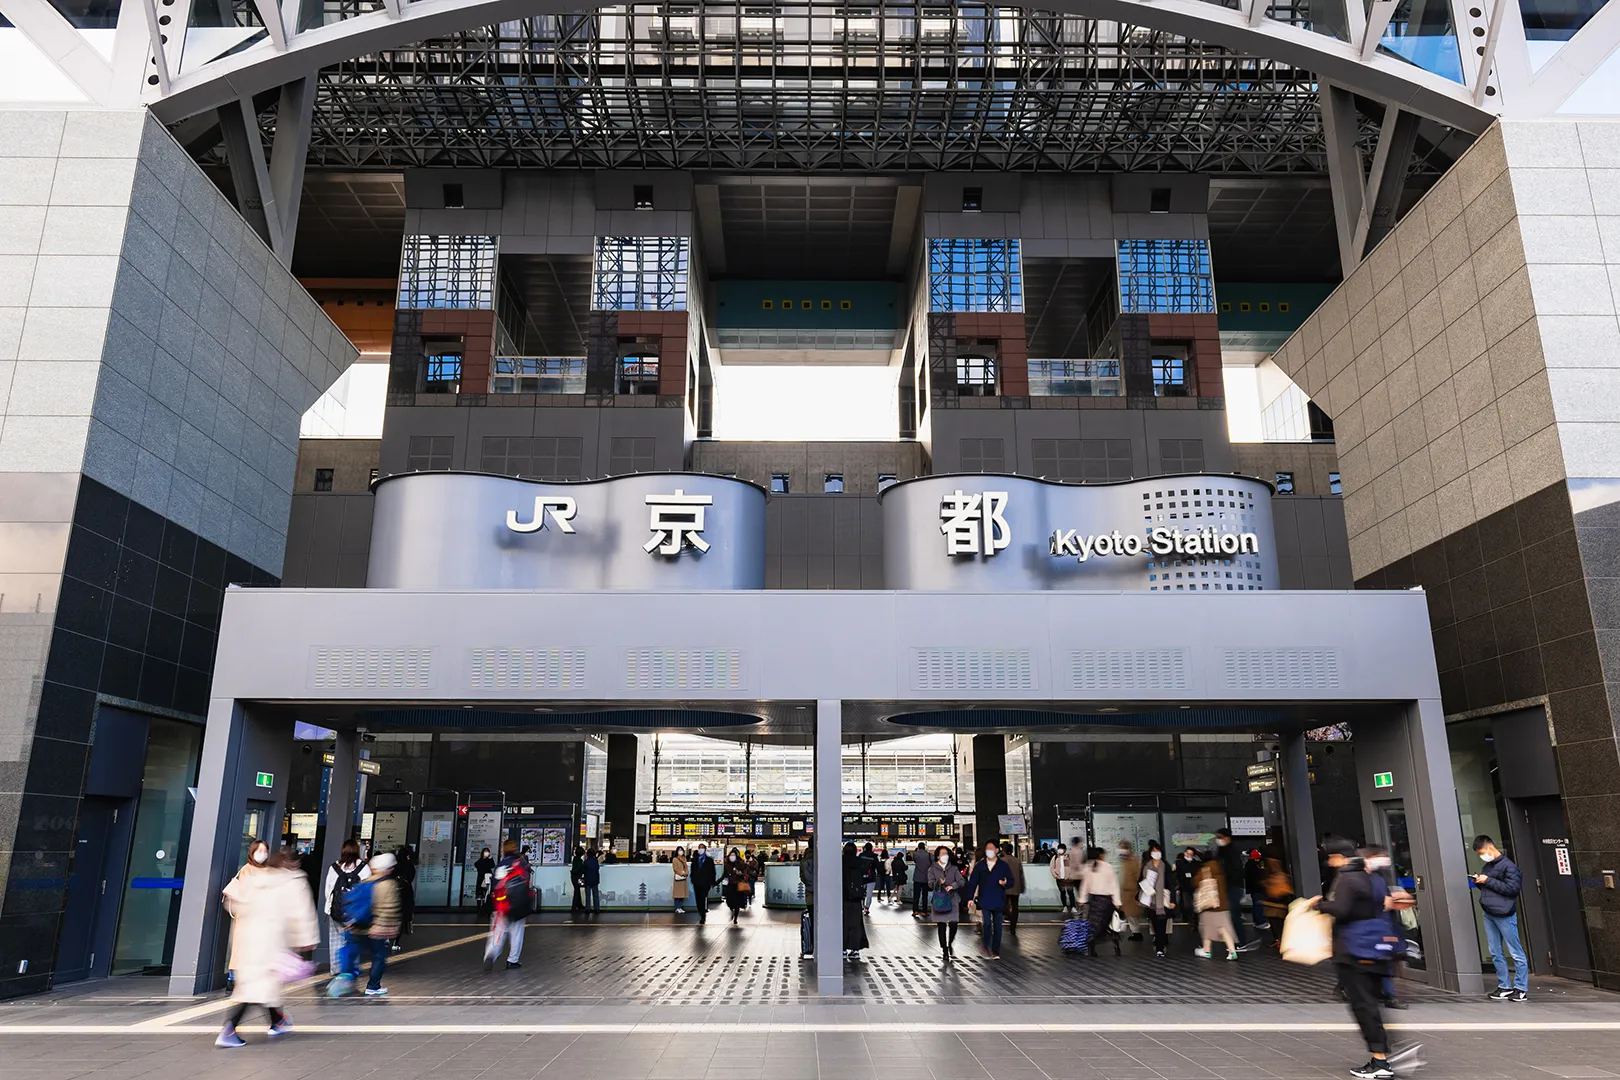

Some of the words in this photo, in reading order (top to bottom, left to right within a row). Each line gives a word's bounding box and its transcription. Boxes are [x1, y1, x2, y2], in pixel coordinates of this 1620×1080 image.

[506, 496, 577, 533] JR
[643, 489, 713, 555] 京
[940, 490, 1011, 556] 都
[1054, 528, 1142, 562] Kyoto
[1151, 527, 1259, 555] Station
